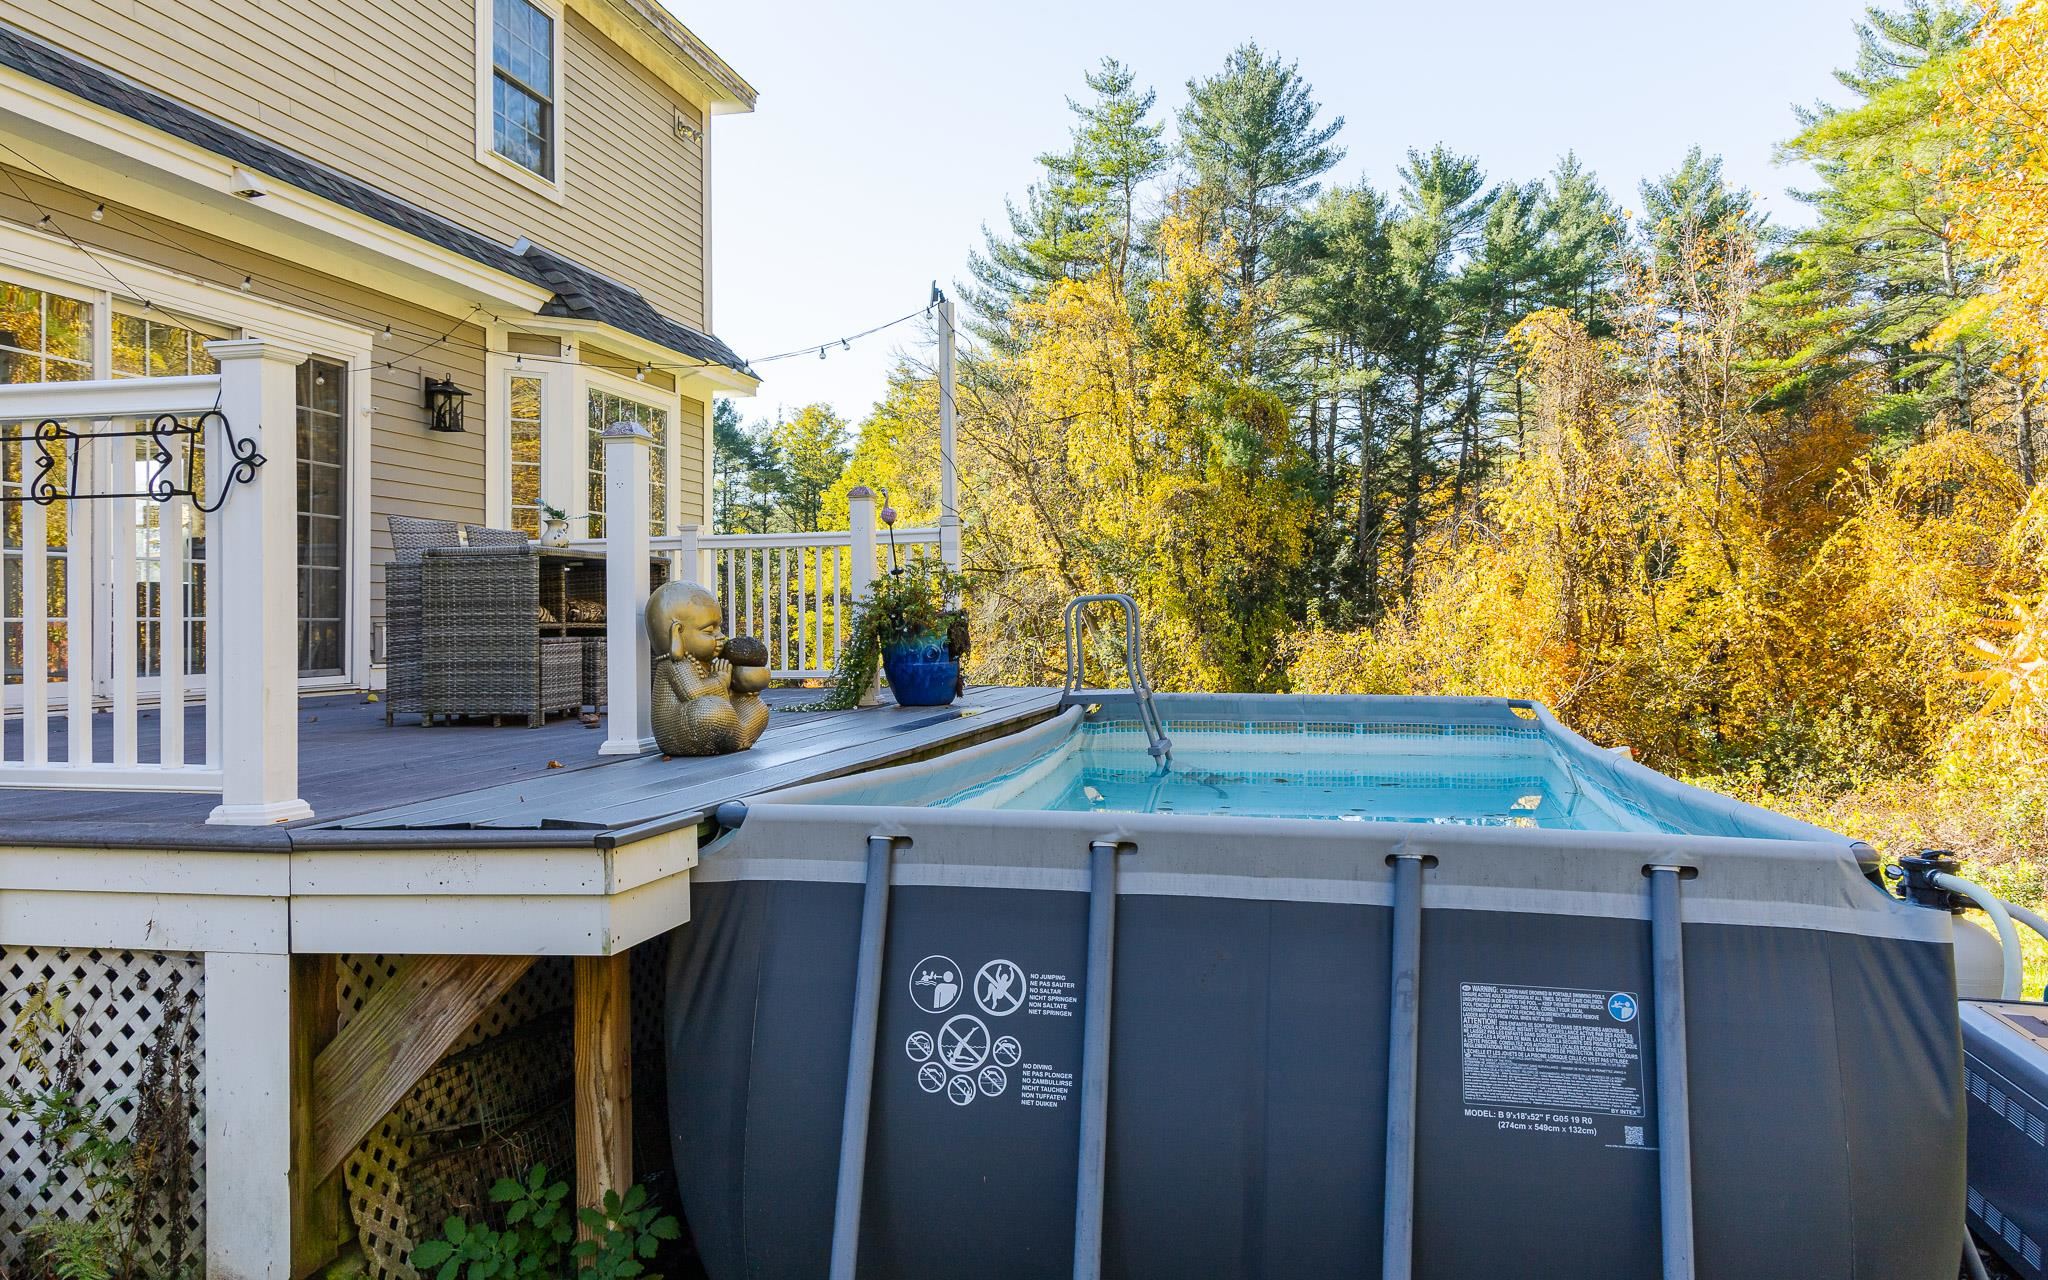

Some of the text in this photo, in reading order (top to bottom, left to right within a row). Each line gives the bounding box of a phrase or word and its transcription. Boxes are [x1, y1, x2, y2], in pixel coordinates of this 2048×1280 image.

[1463, 1017, 1497, 1026] ATTENTION!
[1465, 1109, 1496, 1118] MODEL:
[1498, 1121, 1526, 1129] (274cm
[1535, 1123, 1559, 1132] 549cm
[1569, 1126, 1597, 1136] 132cm)
